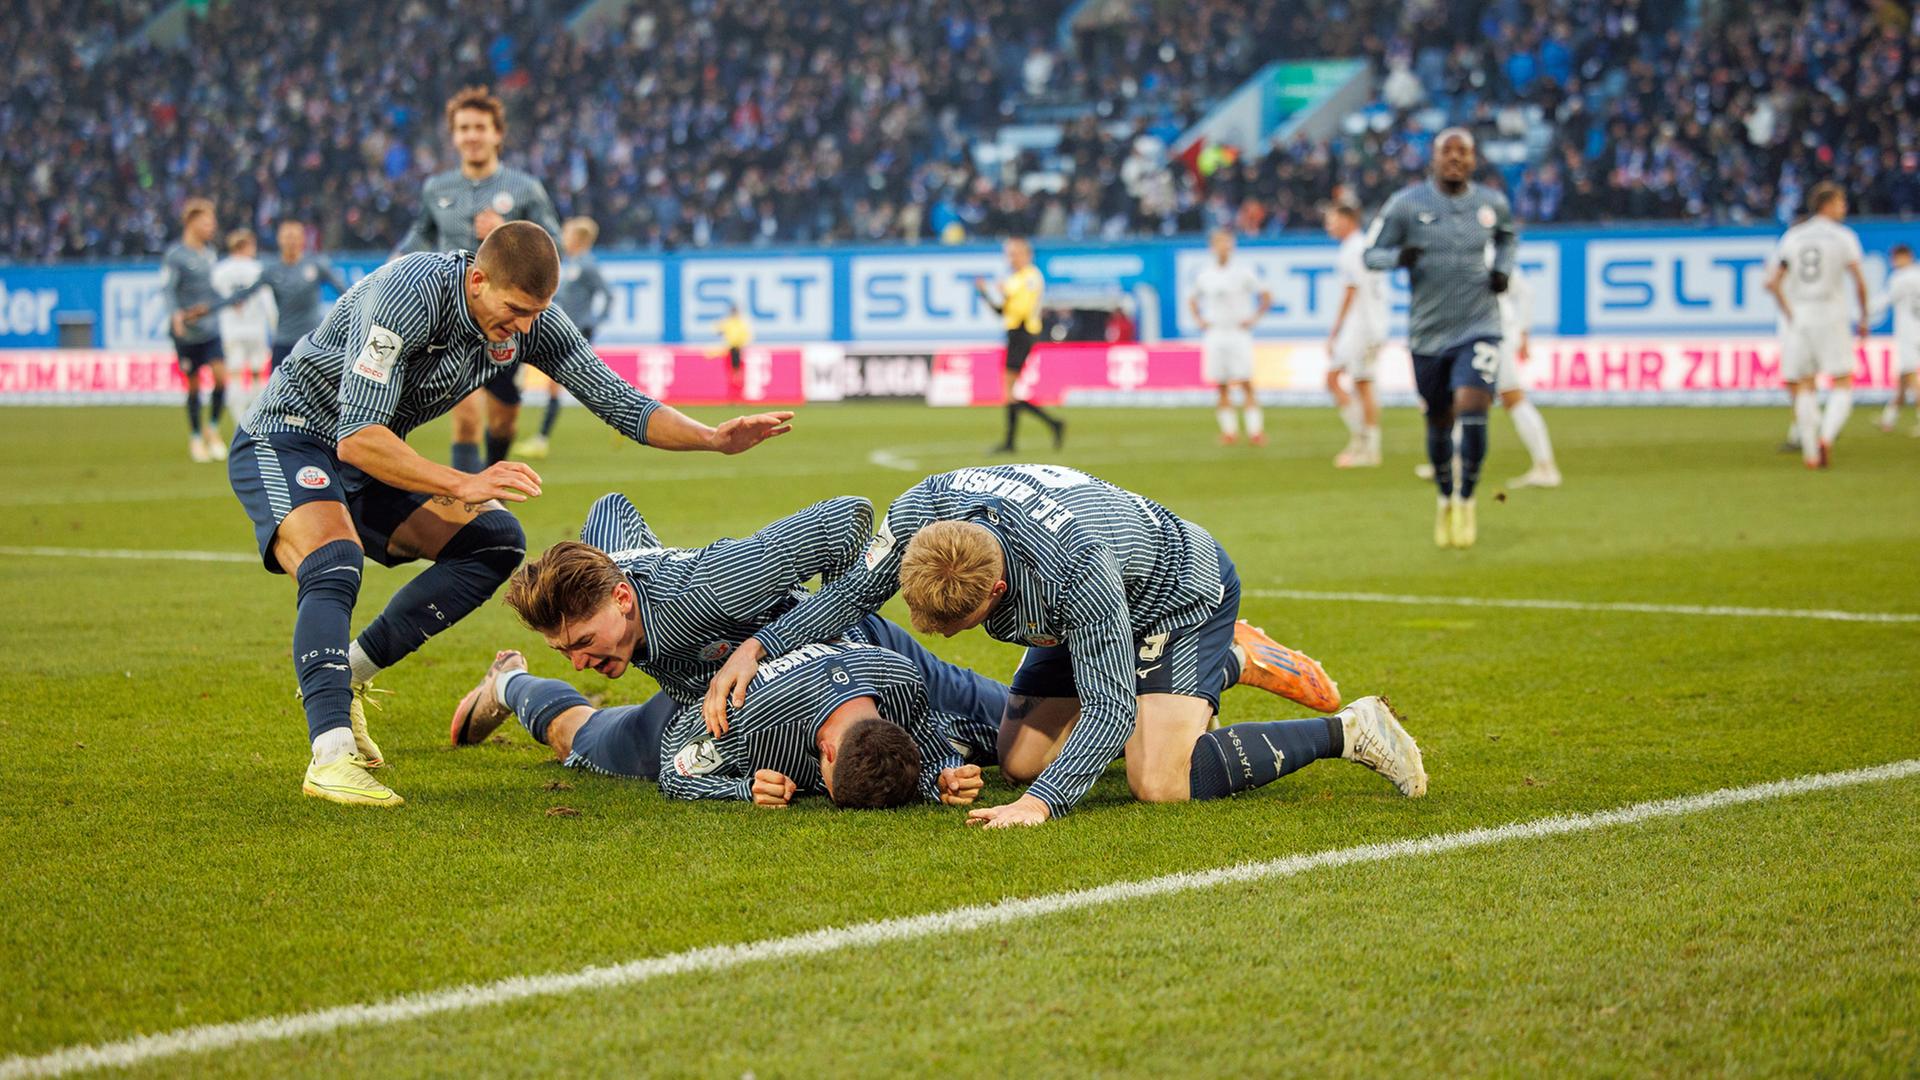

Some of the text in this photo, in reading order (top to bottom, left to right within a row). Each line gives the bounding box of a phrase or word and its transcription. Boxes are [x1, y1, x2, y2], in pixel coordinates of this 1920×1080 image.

[1602, 261, 1768, 308] SLT
[1801, 247, 1821, 283] 8
[695, 275, 826, 322] SLT
[867, 271, 996, 318] SLT
[1536, 351, 1664, 390] JAHR
[1684, 350, 1783, 390] ZUM
[1227, 728, 1254, 779] HANSA
